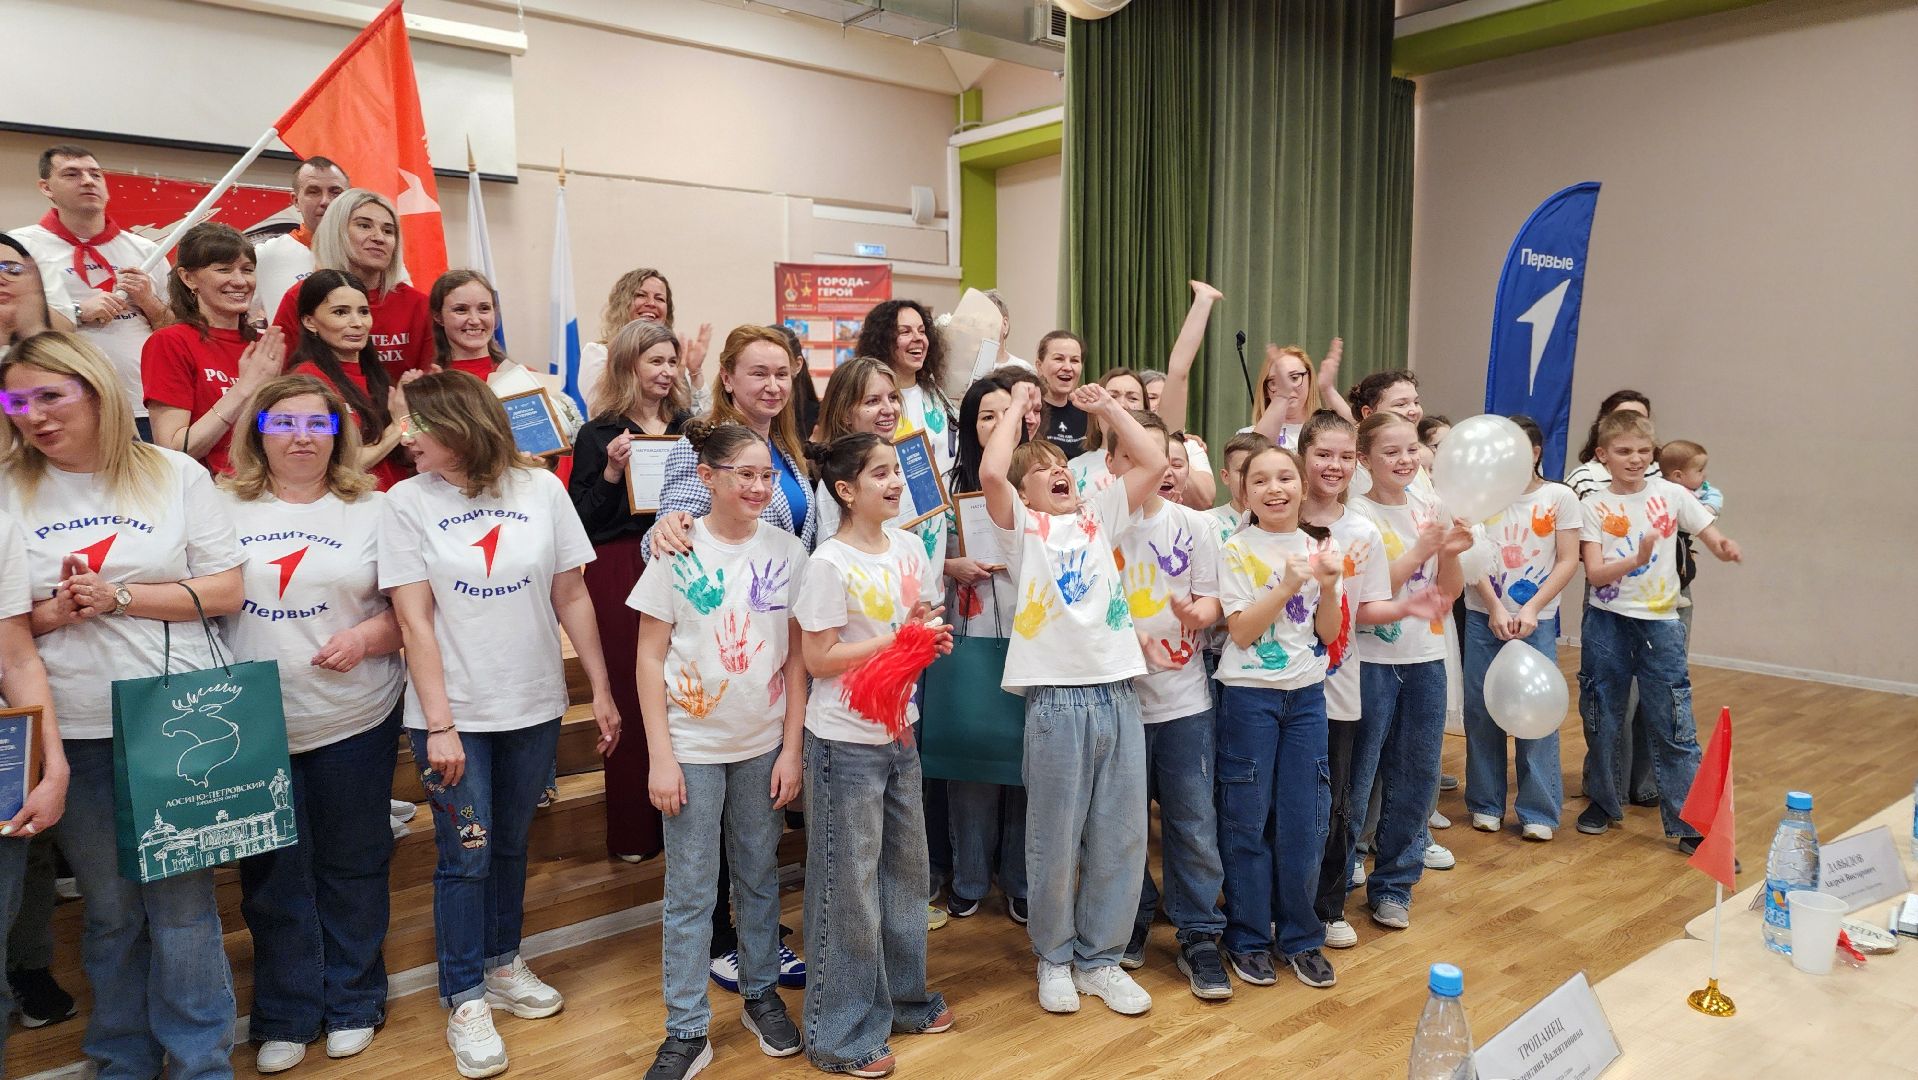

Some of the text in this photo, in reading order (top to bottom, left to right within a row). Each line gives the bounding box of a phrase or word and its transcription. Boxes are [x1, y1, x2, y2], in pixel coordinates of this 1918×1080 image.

[1520, 248, 1574, 271] Первые
[817, 276, 871, 287] ГОРОДА-
[817, 288, 854, 297] ГЕРОИ
[34, 515, 155, 540] Родители
[438, 508, 529, 531] Родители
[240, 530, 343, 549] Родители
[453, 575, 533, 599] Первых
[241, 599, 330, 622] Первых
[165, 779, 266, 809] ЛОСИНО-ПЕТРОВСКИЙ
[1517, 1016, 1567, 1061] ТРОПАНЕЦ
